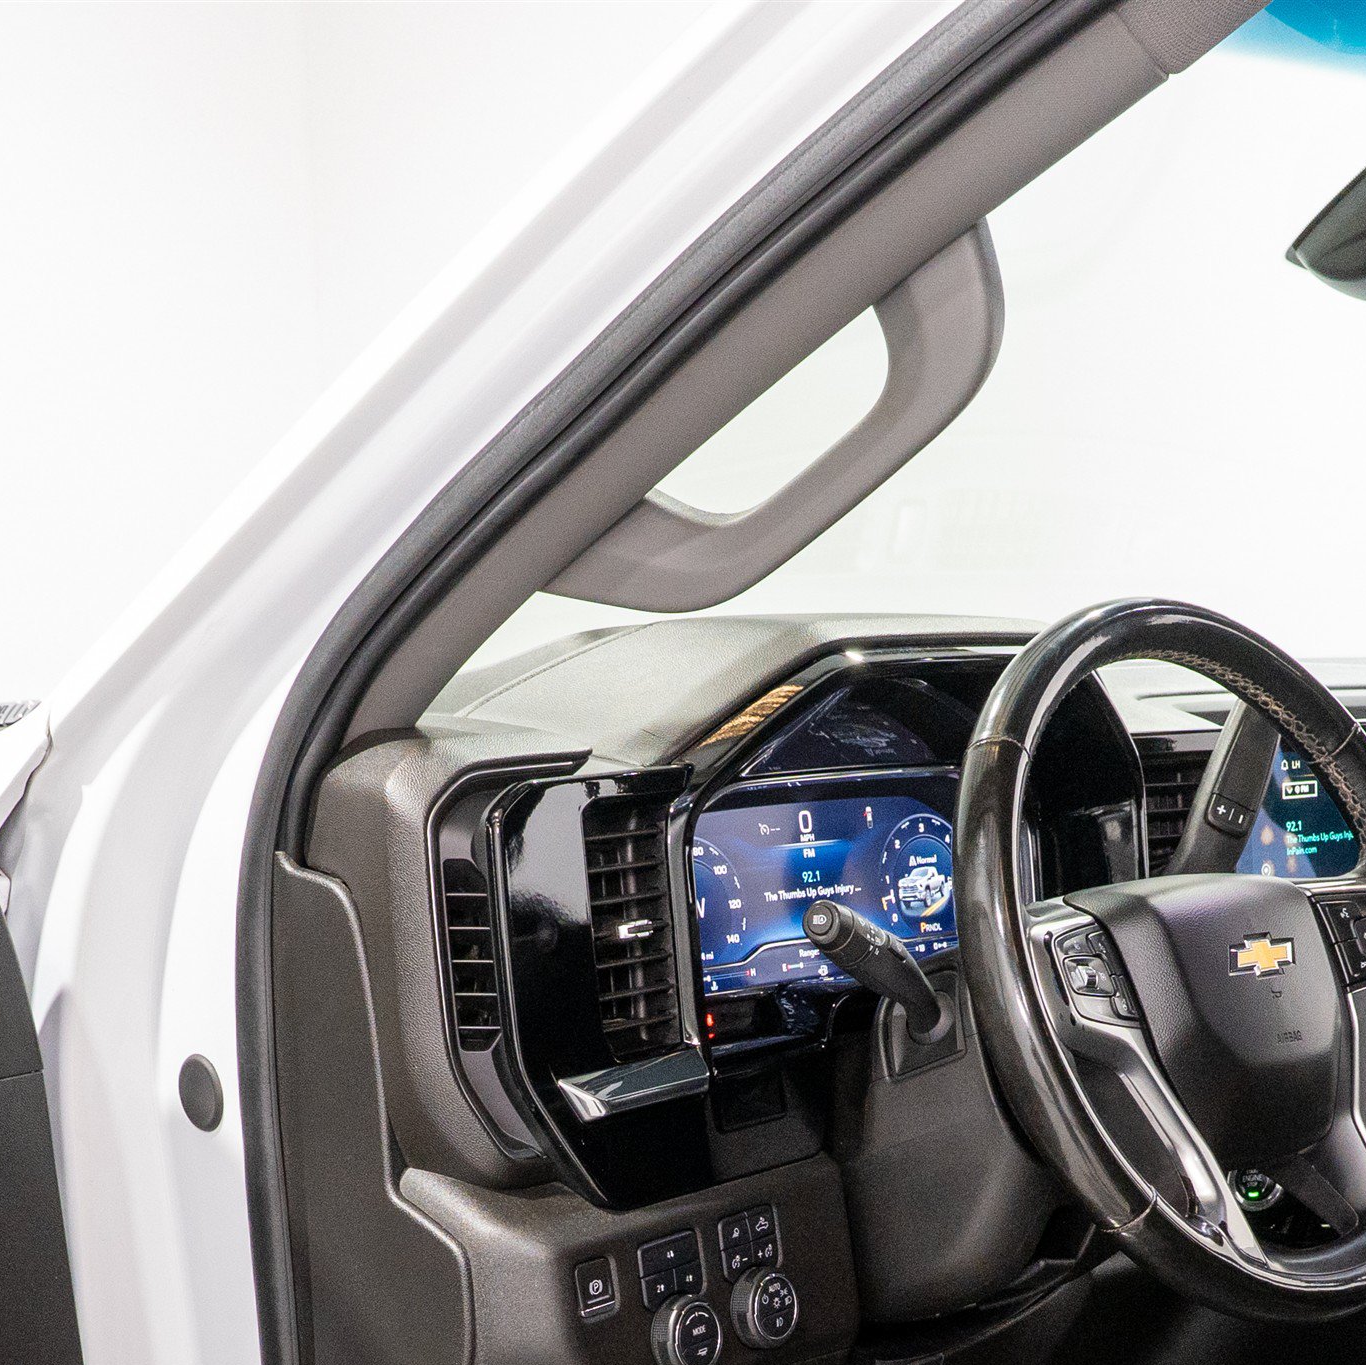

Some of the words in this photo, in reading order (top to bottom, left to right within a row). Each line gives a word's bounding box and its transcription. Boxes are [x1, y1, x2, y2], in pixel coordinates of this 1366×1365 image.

[798, 810, 812, 833] 0
[1286, 821, 1302, 832] 92.1
[919, 823, 924, 833] 3
[800, 833, 815, 842] MPH
[1298, 833, 1320, 843] Thumbs
[1320, 832, 1330, 842] Up
[1329, 831, 1344, 842] Guys
[895, 839, 900, 849] 2
[803, 848, 815, 858] FM
[916, 854, 938, 864] Normal
[713, 865, 728, 876] 100
[802, 870, 821, 883] 92.1
[764, 892, 778, 902] The
[778, 888, 806, 900] Thumbs
[806, 887, 817, 898] Up
[817, 886, 834, 898] Guys
[835, 884, 854, 895] Injury
[728, 899, 741, 910] 120
[892, 913, 898, 923] 0
[726, 933, 740, 945] 140
[750, 968, 757, 977] H
[692, 1324, 706, 1336] MODE
